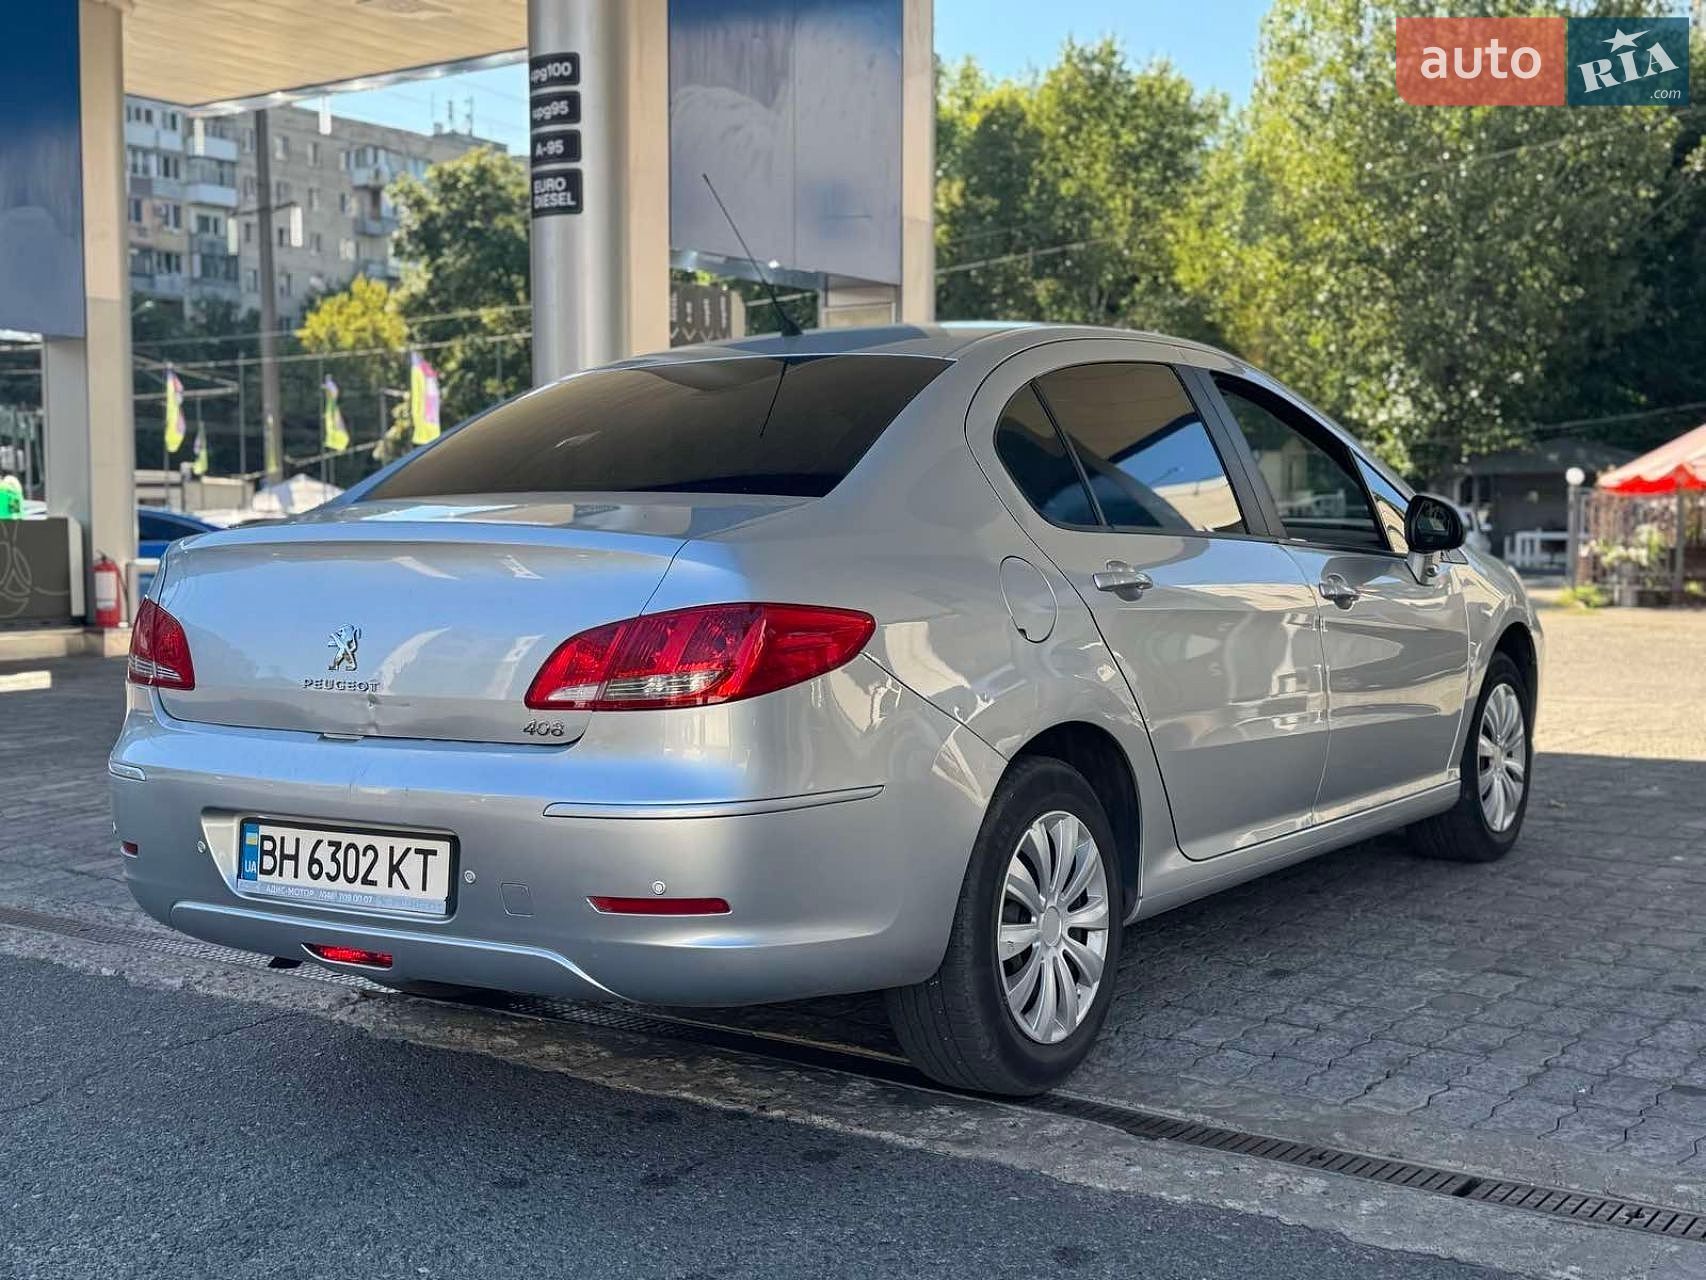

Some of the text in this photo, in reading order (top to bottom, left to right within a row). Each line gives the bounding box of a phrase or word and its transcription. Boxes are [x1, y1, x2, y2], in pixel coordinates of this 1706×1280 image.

[536, 139, 565, 158] A-95
[534, 177, 566, 194] EURO
[534, 192, 576, 209] DIESEL
[303, 679, 380, 692] PEUGEOT
[522, 719, 565, 737] 408
[245, 861, 257, 873] UA
[259, 834, 438, 892] BH 6302 KT
